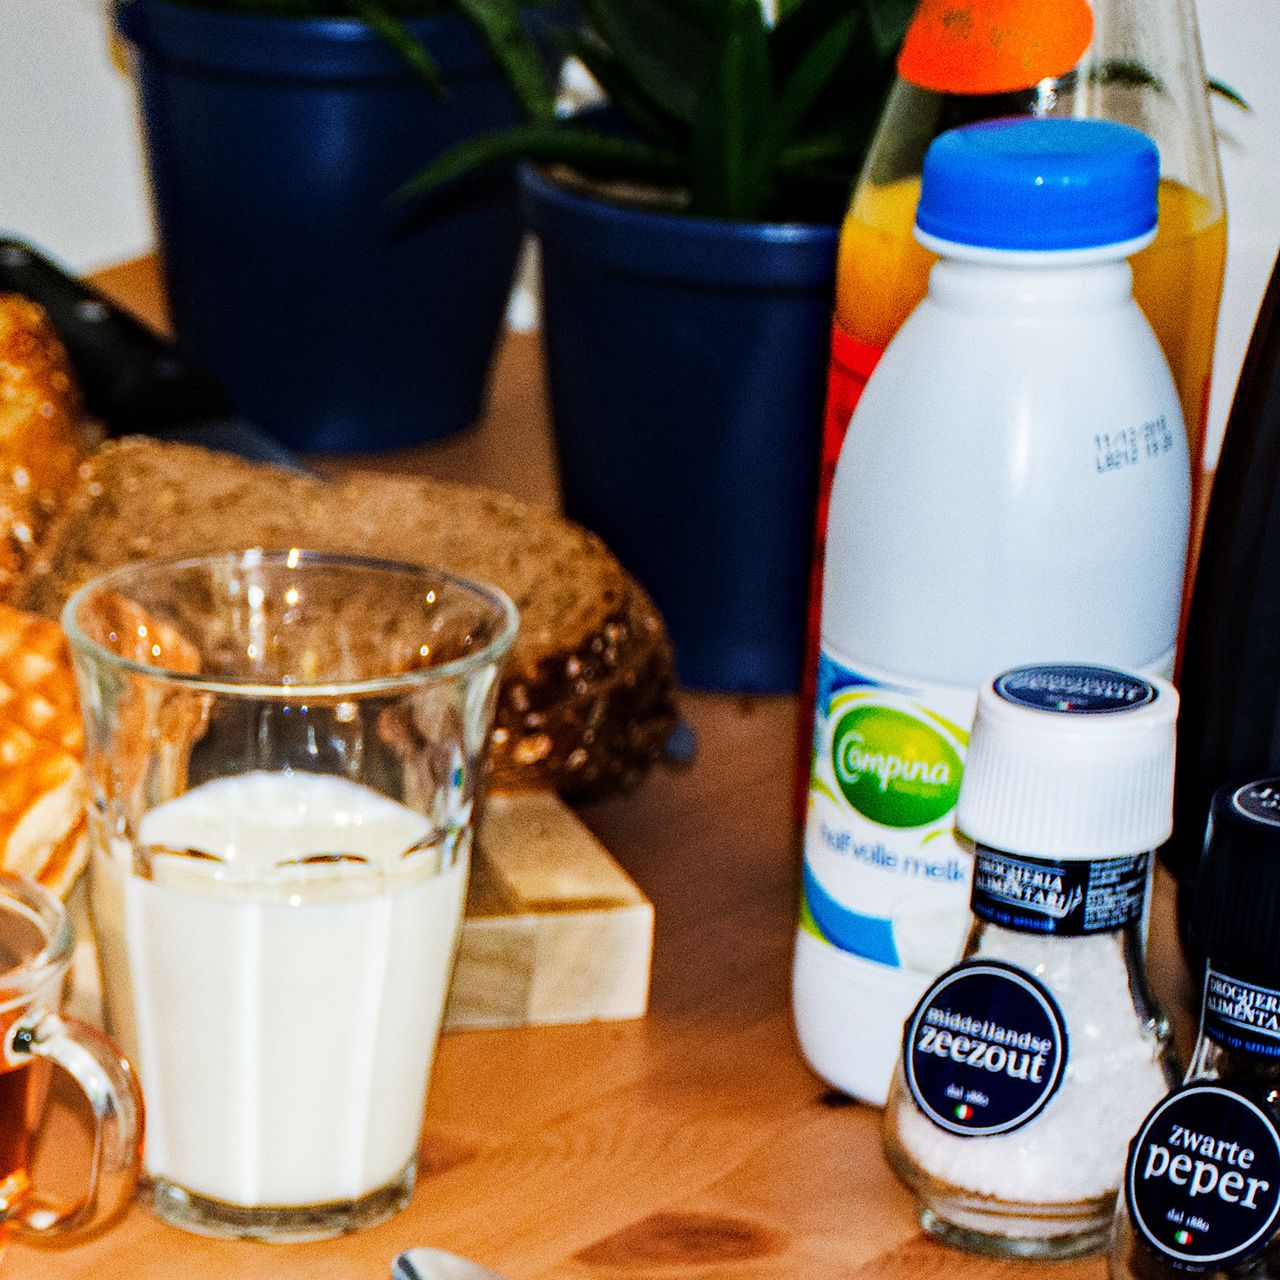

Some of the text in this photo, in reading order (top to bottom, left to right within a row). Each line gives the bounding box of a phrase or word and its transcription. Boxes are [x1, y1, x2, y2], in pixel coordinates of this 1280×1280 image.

[838, 730, 950, 793] Campina
[904, 857, 967, 885] melk
[926, 1008, 1052, 1055] middellandse
[1208, 996, 1280, 1032] ALIMENTA
[917, 1025, 1047, 1084] zeezout
[1168, 1124, 1255, 1170] zwarte
[1144, 1144, 1270, 1210] peper
[1167, 1208, 1184, 1223] dal
